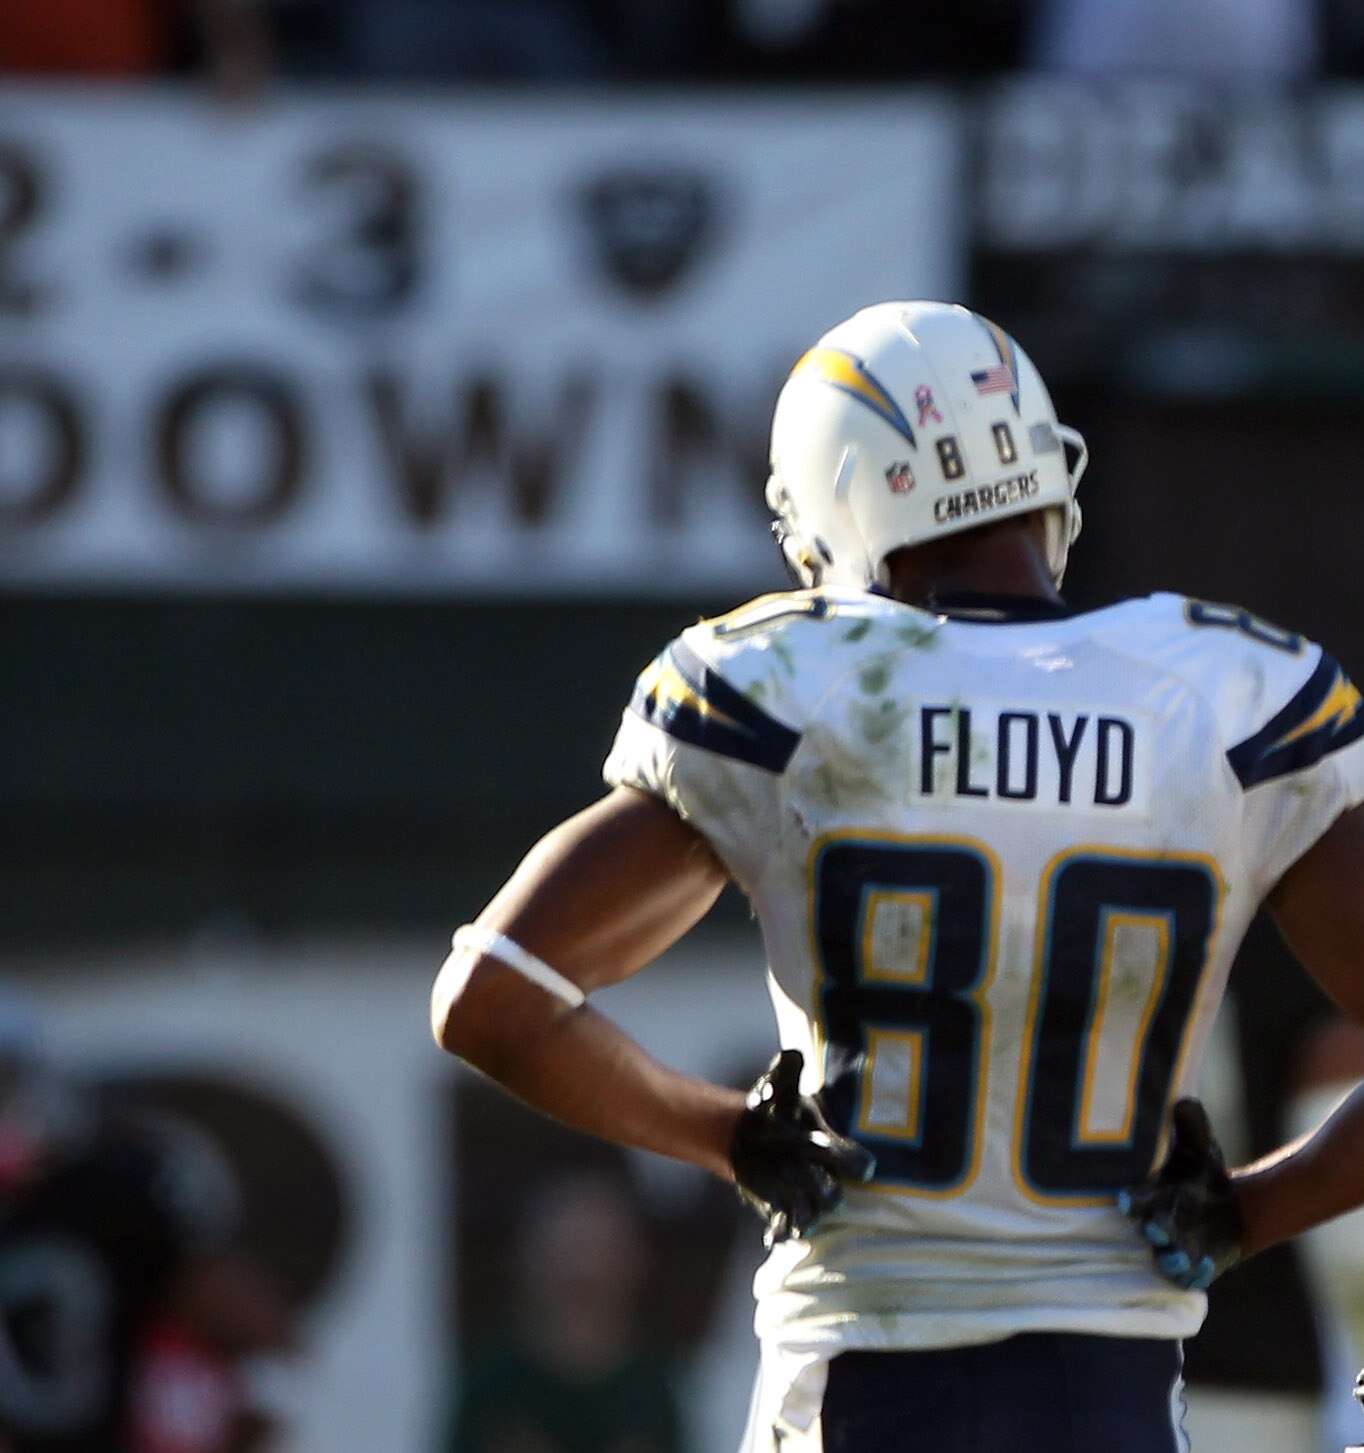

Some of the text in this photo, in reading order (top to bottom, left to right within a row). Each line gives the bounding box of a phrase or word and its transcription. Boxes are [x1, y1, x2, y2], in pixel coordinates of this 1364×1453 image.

[933, 469, 1040, 522] CHARGERS
[920, 706, 1136, 806] FLOYD
[808, 828, 1226, 1208] 80
